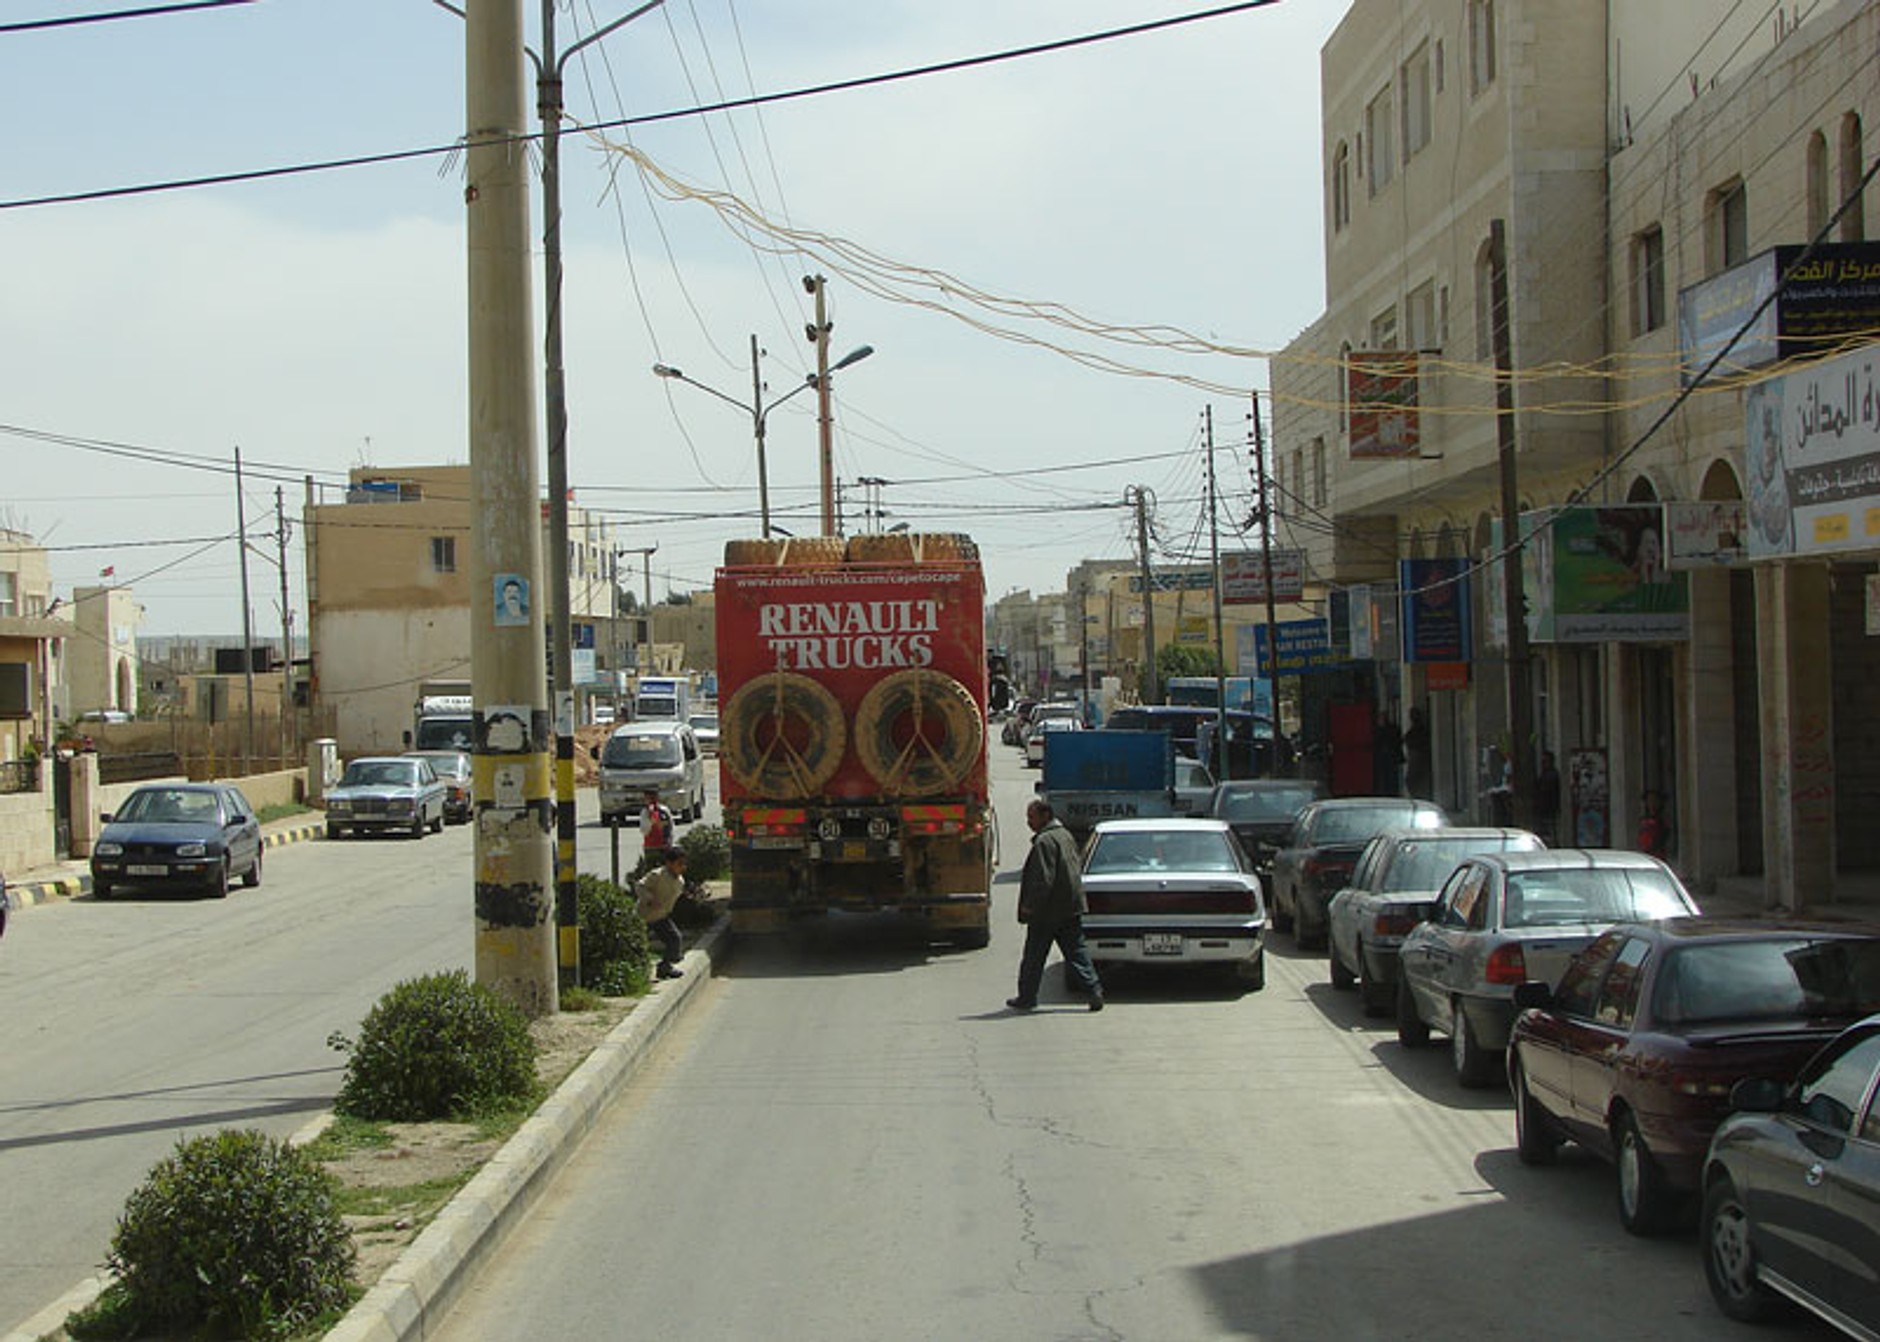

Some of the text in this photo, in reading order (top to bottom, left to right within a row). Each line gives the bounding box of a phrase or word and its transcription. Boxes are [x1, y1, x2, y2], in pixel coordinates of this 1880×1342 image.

[1797, 370, 1858, 449] المدائن
[758, 600, 941, 636] RENAULT
[768, 635, 932, 669] TRUCKS
[1066, 803, 1138, 816] NISSAN
